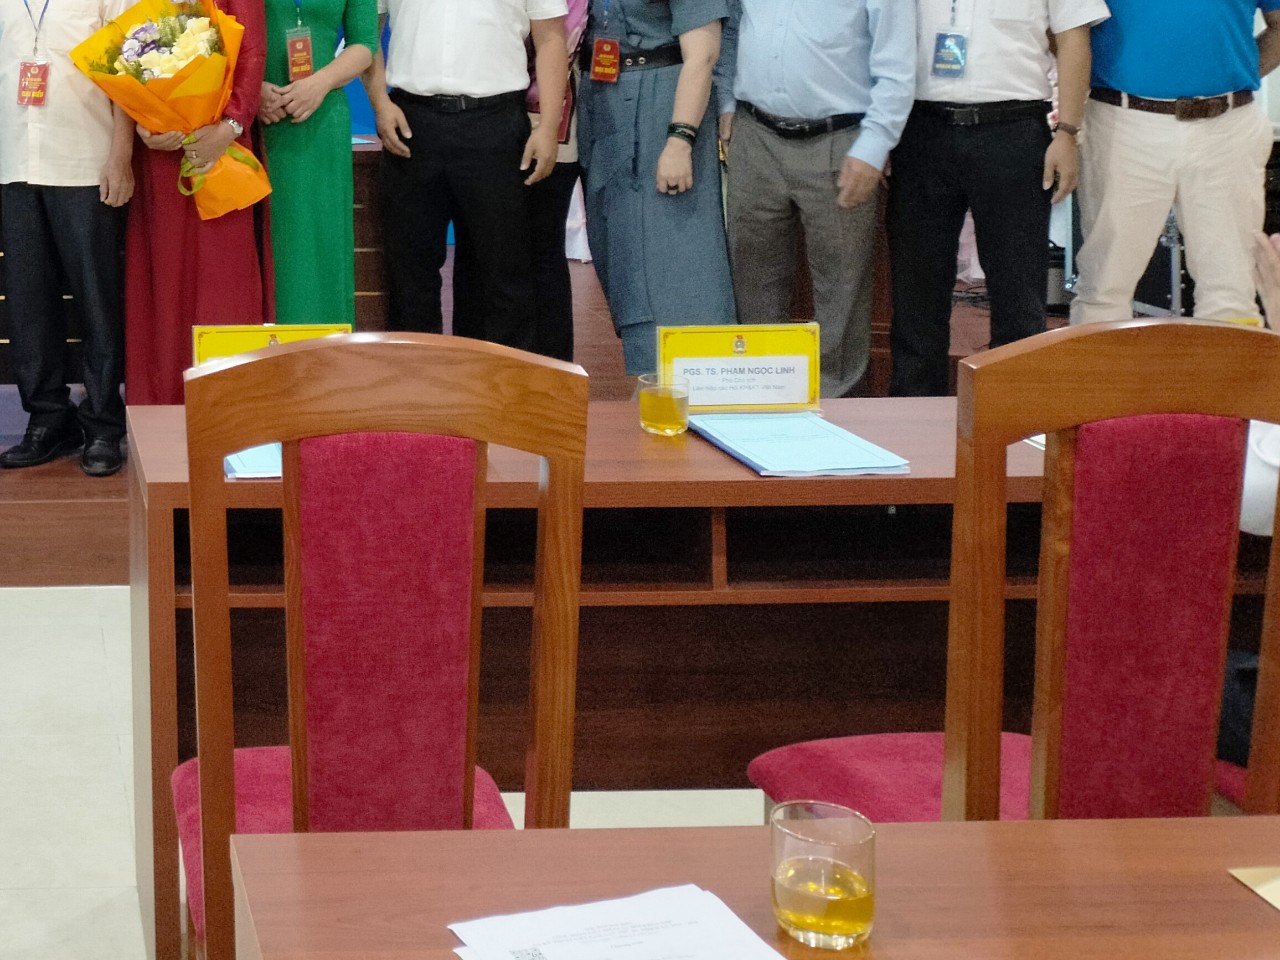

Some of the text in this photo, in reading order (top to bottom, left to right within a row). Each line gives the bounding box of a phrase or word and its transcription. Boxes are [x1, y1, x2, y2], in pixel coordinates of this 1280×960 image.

[683, 366, 796, 377] PGS. TS. PHẠM NGỌC LINH
